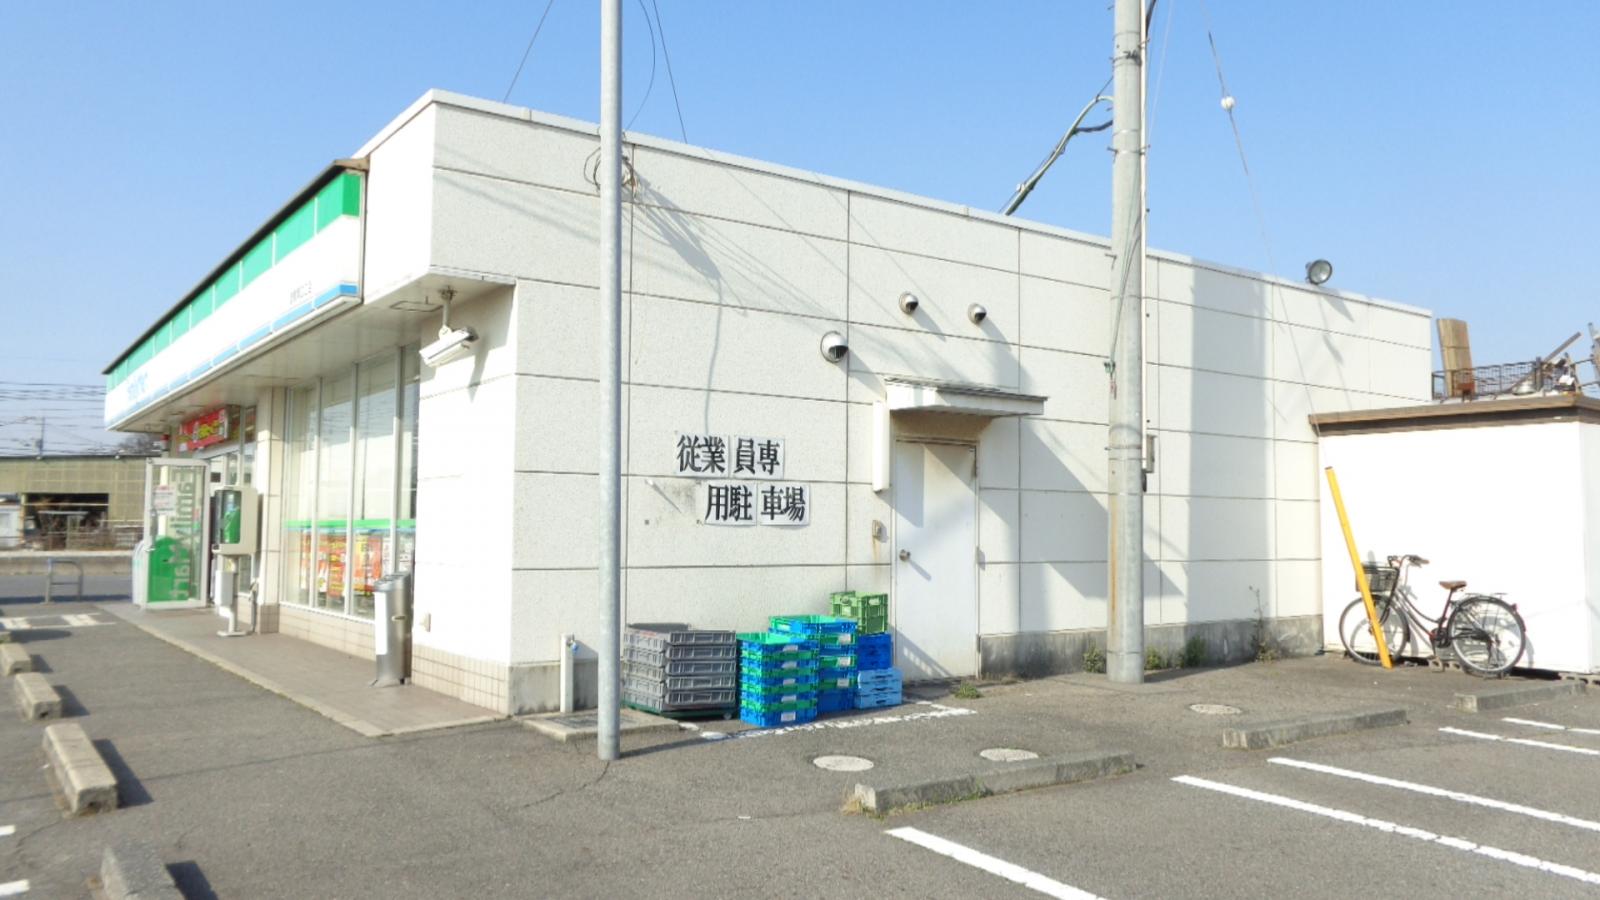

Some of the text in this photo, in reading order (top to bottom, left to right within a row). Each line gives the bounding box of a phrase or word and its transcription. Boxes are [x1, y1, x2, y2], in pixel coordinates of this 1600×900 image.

[677, 435, 780, 475] 従業員専
[705, 484, 806, 521] 用駐車場
